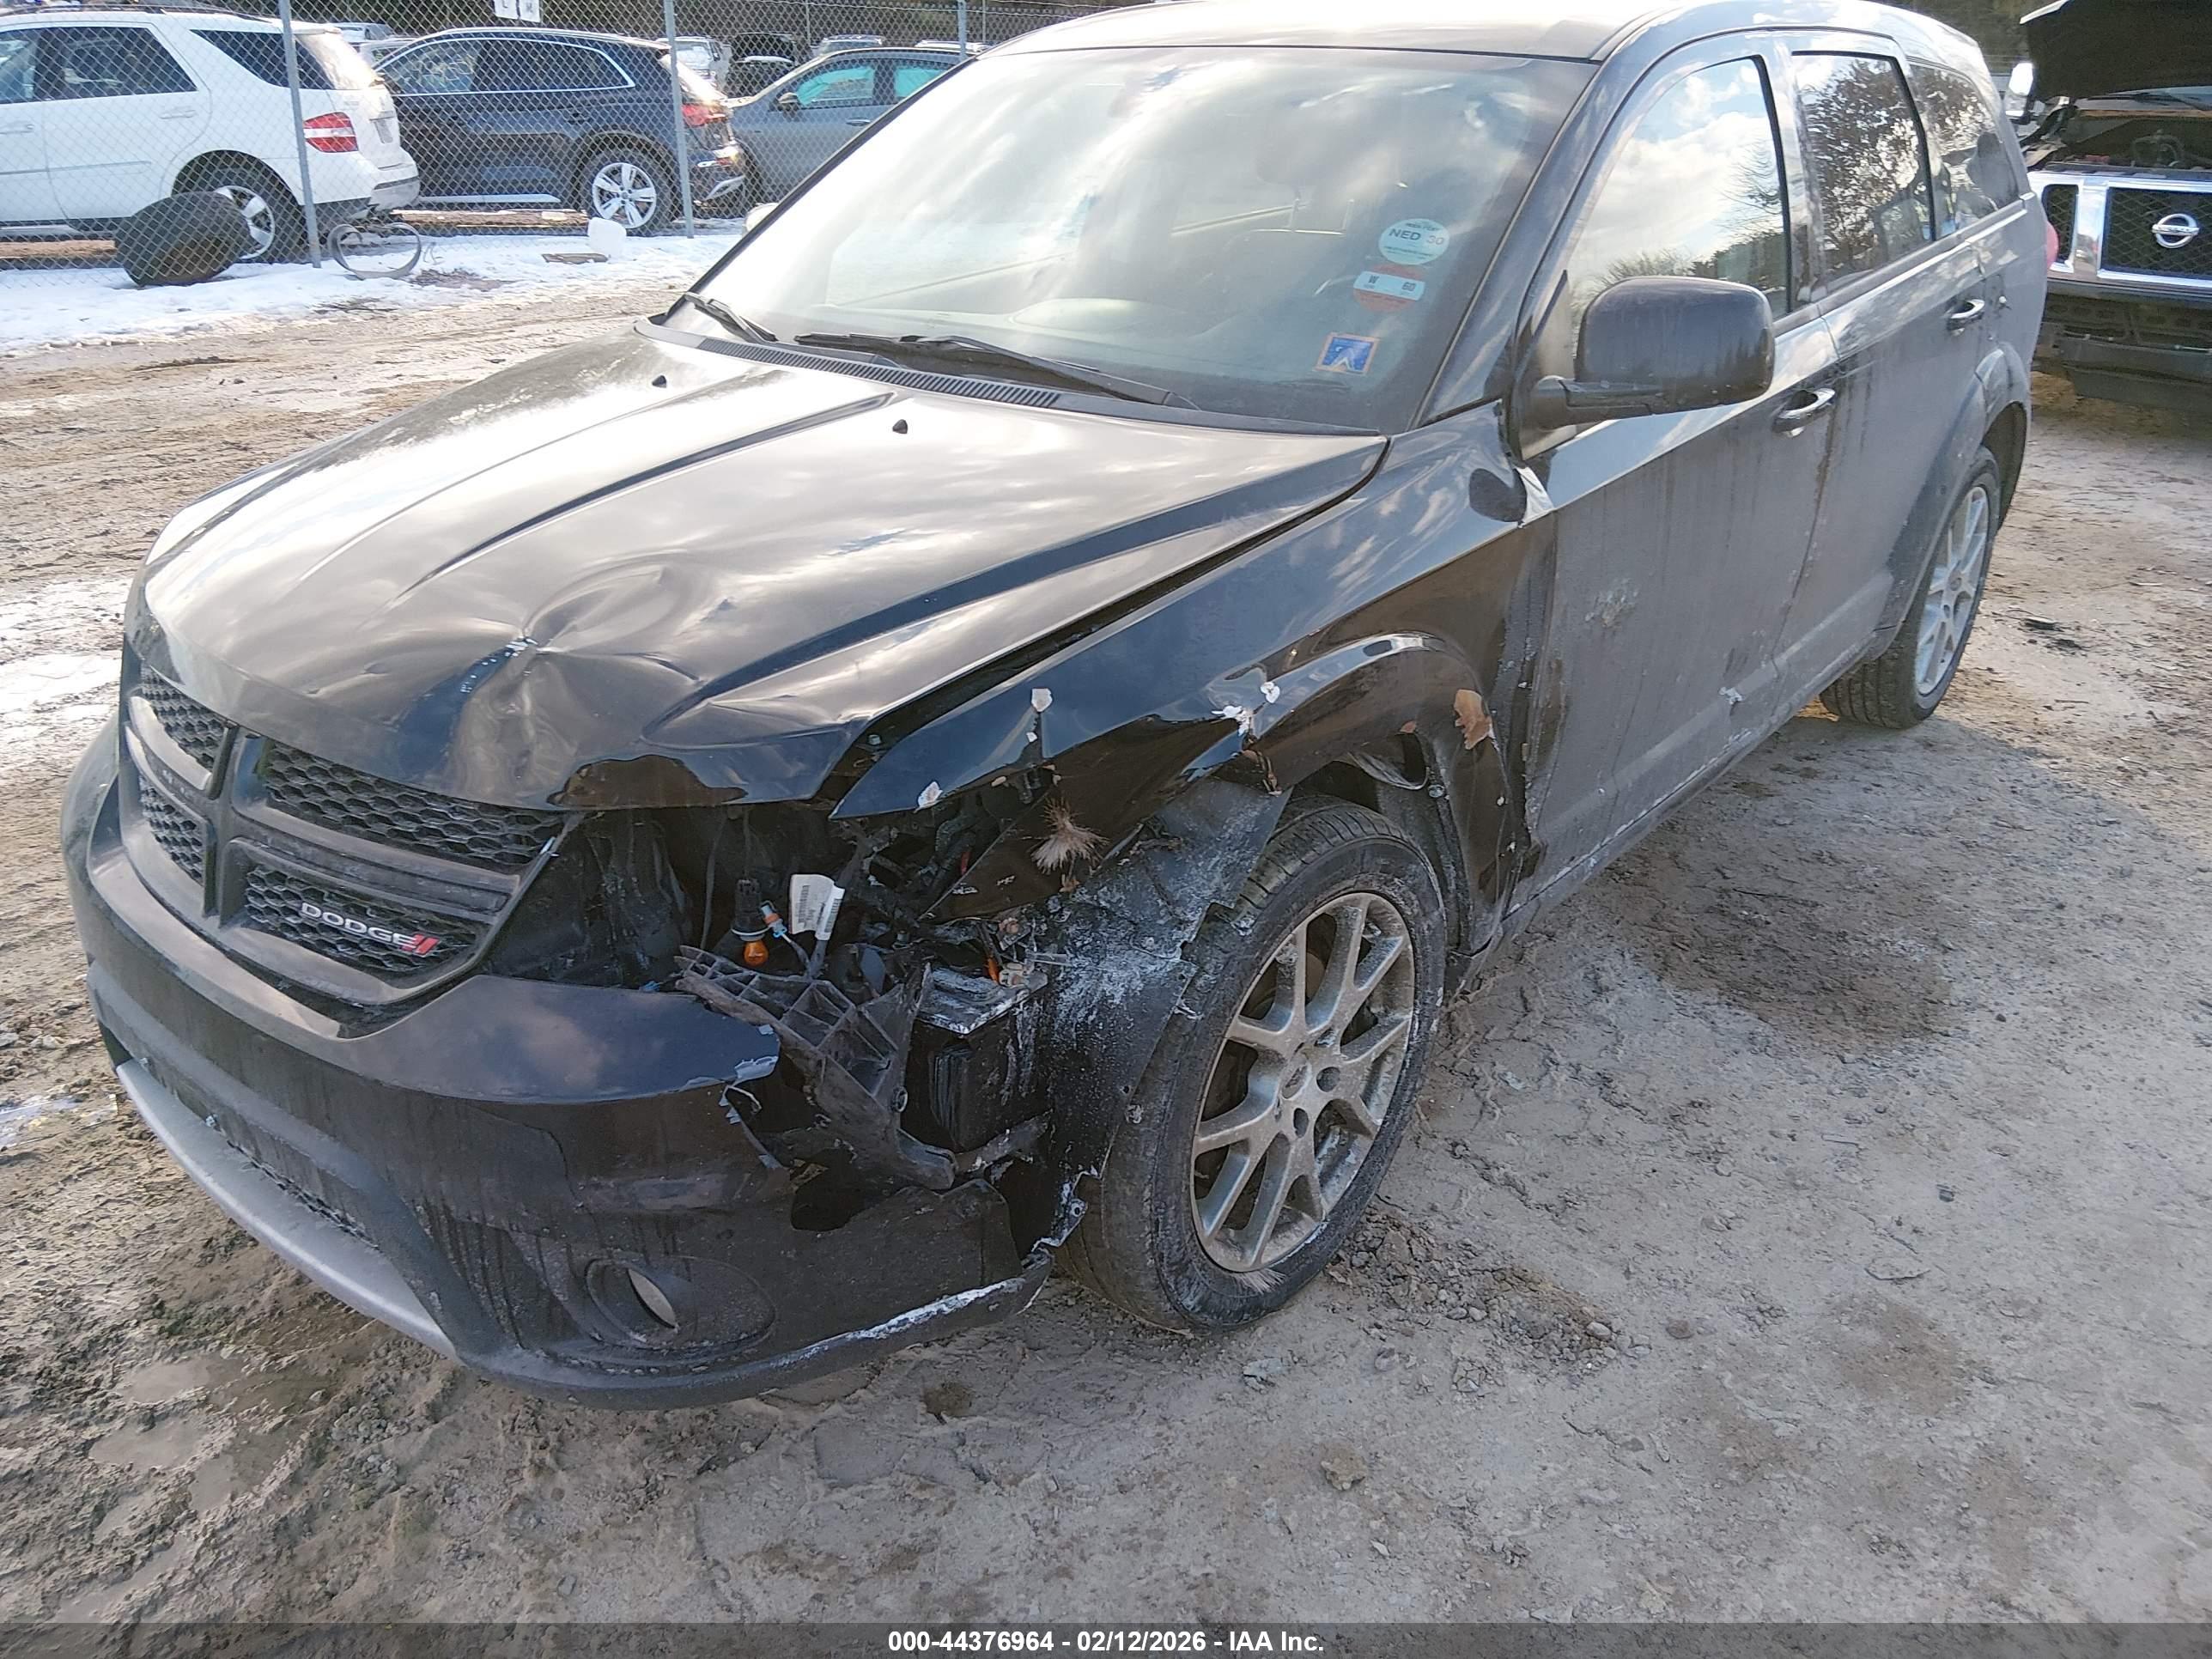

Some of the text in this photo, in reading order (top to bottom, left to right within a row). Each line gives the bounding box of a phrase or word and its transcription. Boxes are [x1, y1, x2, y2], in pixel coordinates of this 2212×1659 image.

[1389, 228, 1445, 246] NED 30
[301, 902, 417, 948] DODGE
